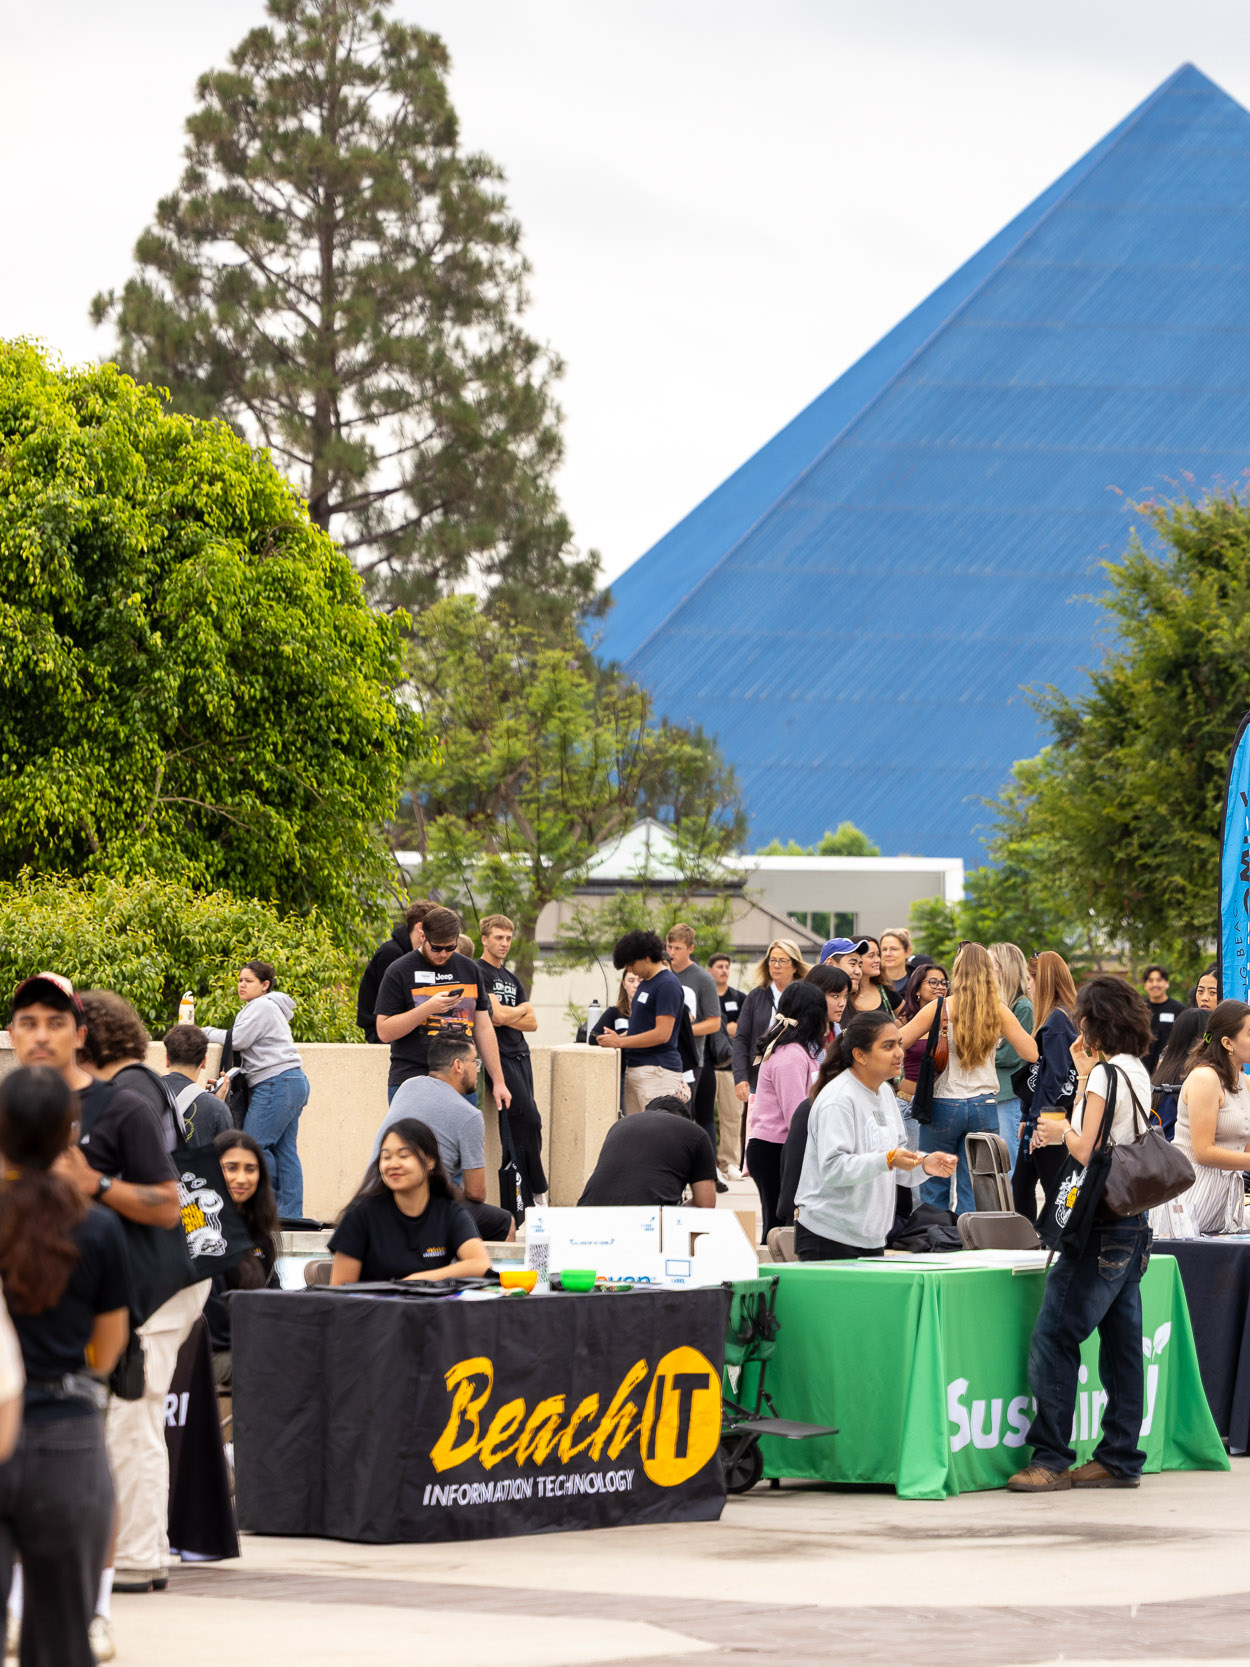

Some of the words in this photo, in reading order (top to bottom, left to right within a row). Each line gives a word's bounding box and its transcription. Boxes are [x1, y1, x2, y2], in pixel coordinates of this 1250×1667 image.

[435, 973, 454, 981] Jeep
[429, 1356, 648, 1474] Beach
[646, 1373, 710, 1460] IT
[422, 1478, 533, 1507] INFORMATION
[536, 1469, 635, 1497] TECHNOLOGY
